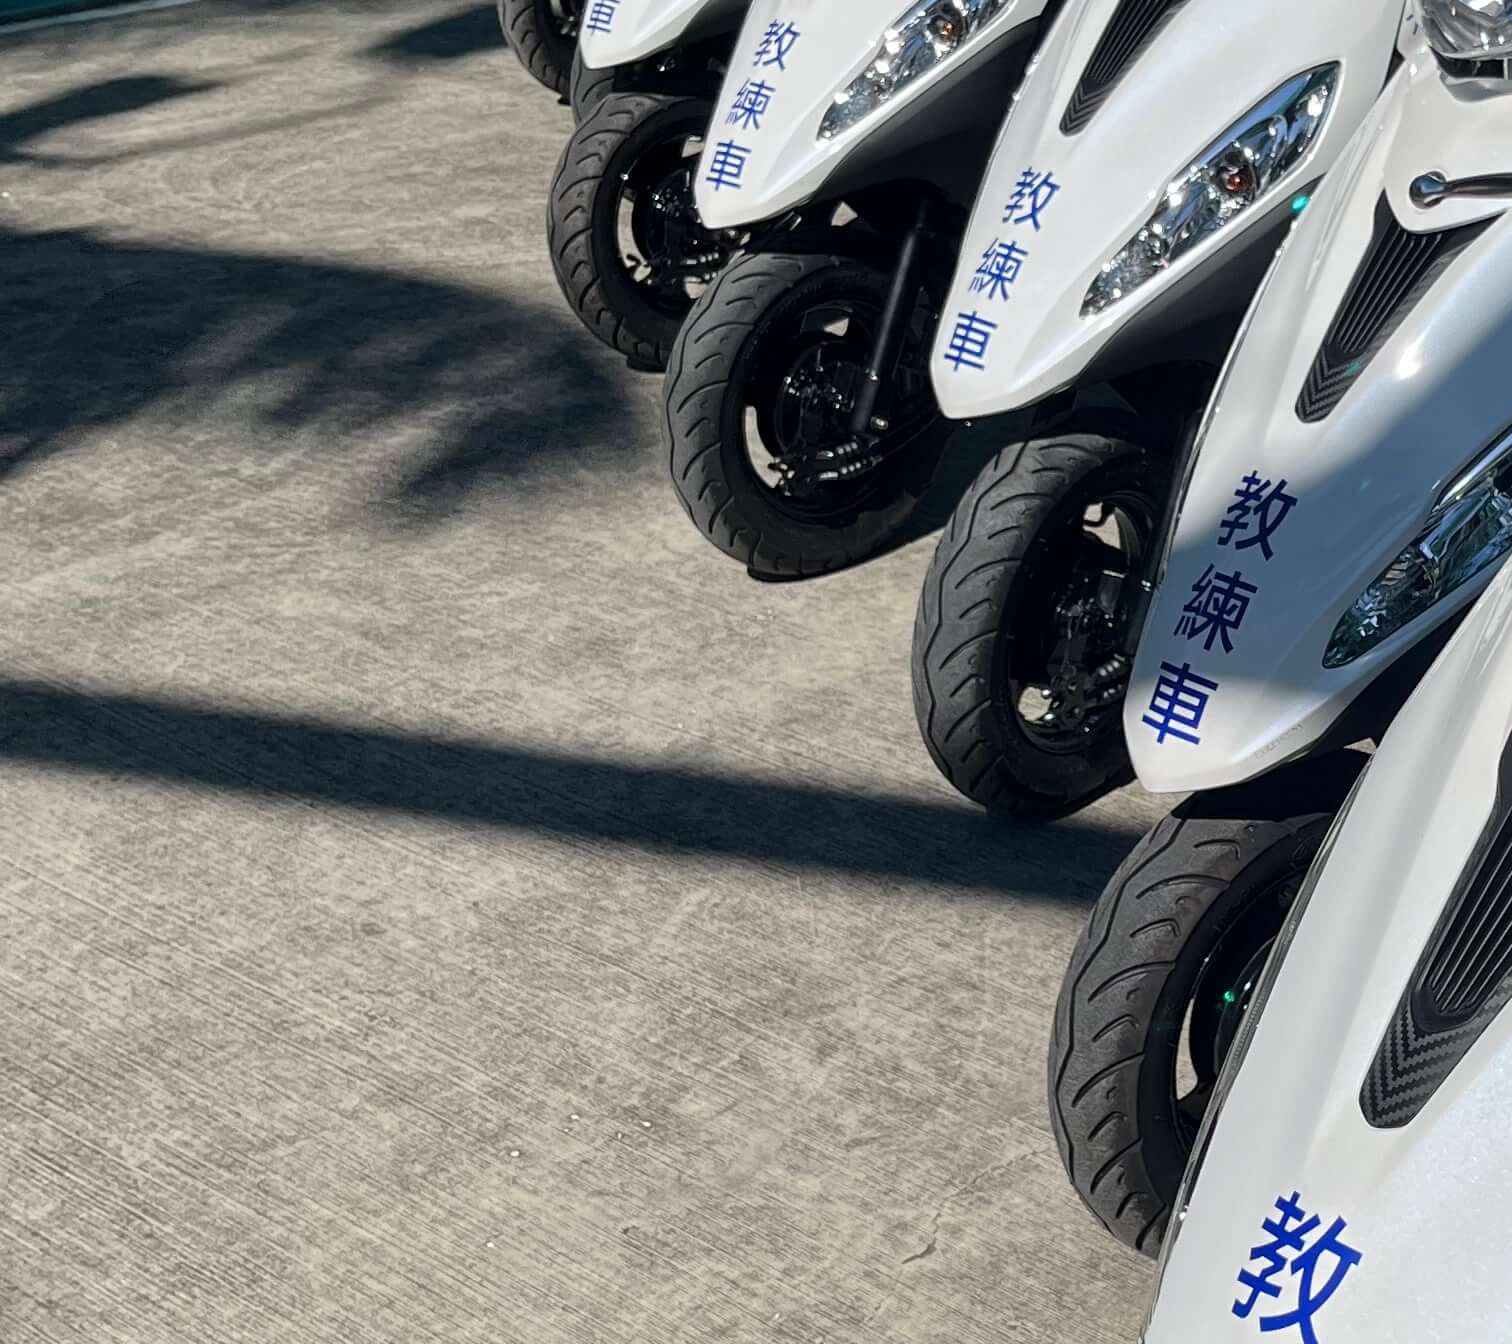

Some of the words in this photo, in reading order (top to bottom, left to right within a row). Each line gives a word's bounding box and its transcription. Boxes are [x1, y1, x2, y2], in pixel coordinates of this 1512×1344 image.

[705, 17, 800, 192] 教練車
[943, 166, 1061, 374] 教練車
[1142, 470, 1299, 747] 教練車
